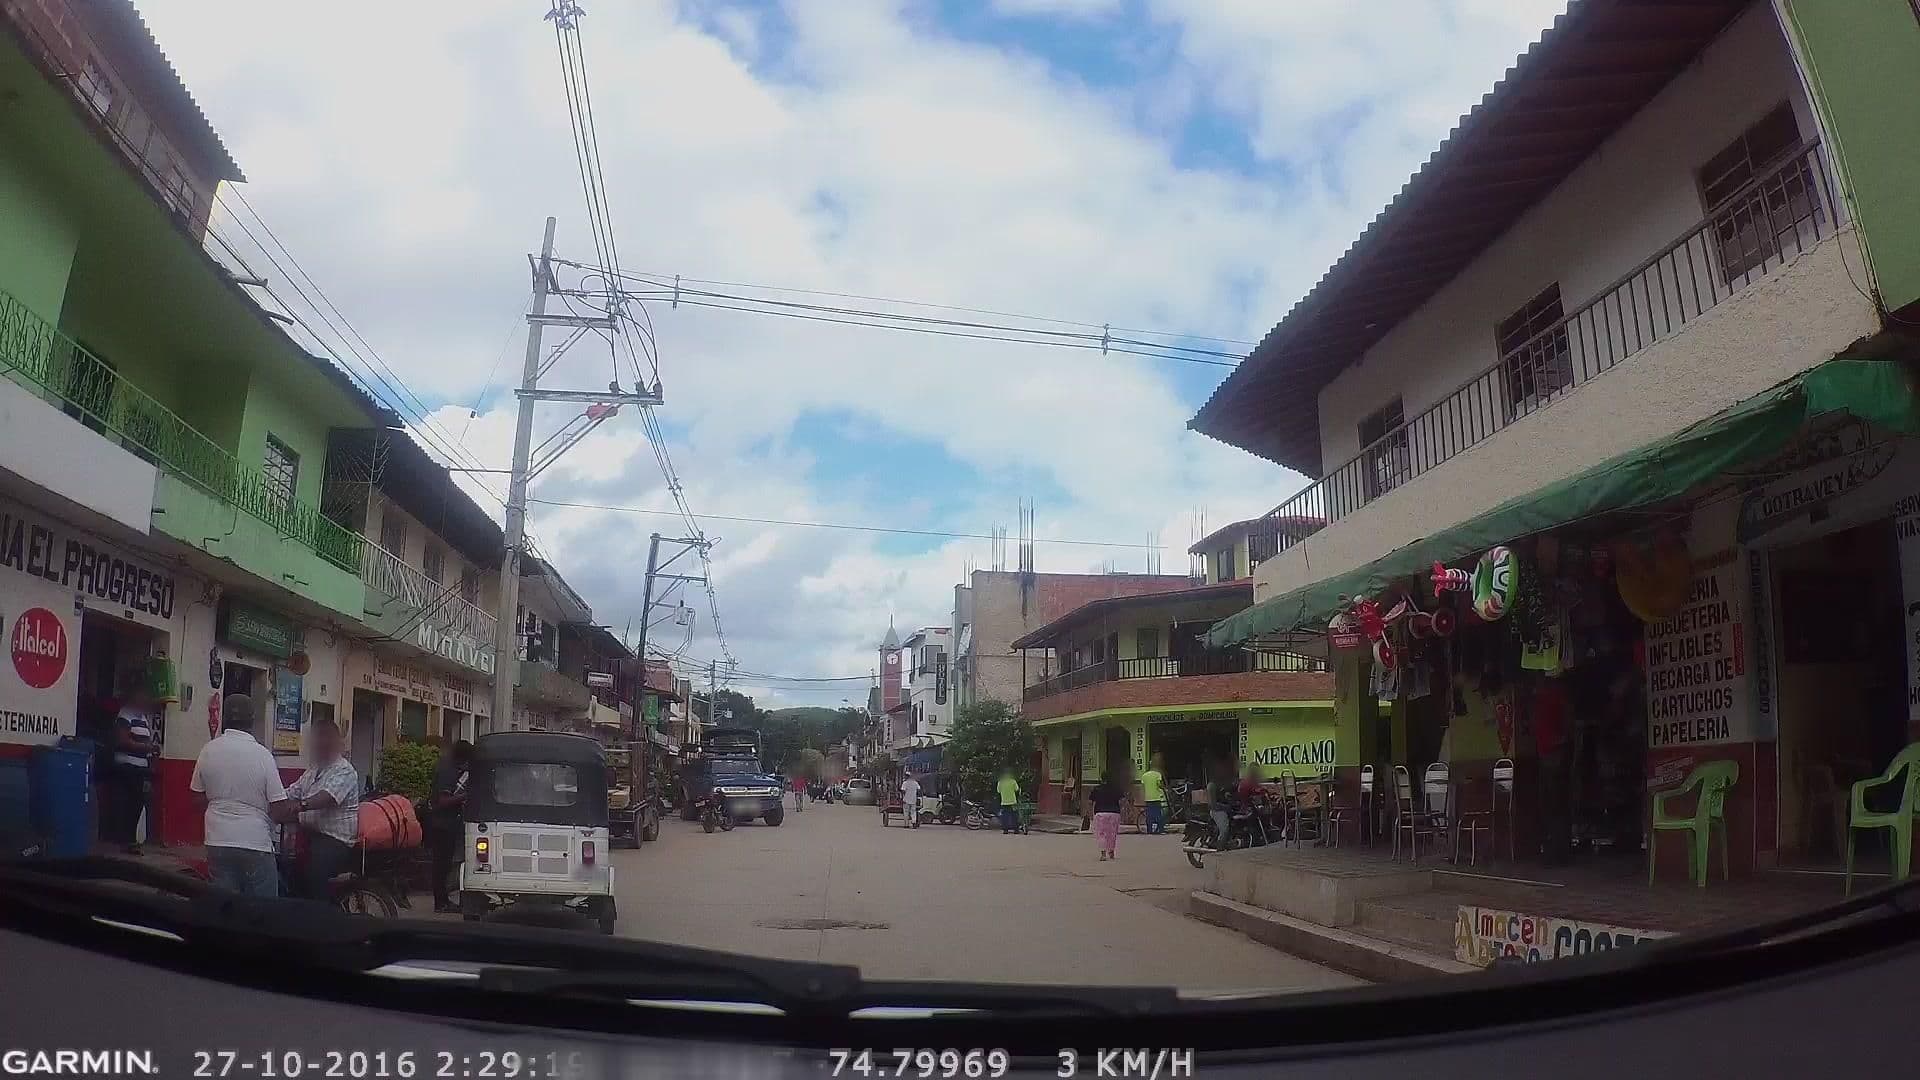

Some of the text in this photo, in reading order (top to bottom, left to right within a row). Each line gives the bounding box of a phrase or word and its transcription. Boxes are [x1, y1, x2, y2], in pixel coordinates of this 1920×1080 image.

[27, 524, 59, 583] EL
[62, 538, 175, 620] PROGRESO
[1649, 631, 1722, 666] INFLABLES
[1651, 657, 1734, 692] RECARGA DE
[1652, 687, 1733, 719] CARTUCHOS
[1653, 715, 1730, 746] PAPELERIA
[1254, 740, 1335, 766] MERCAMO
